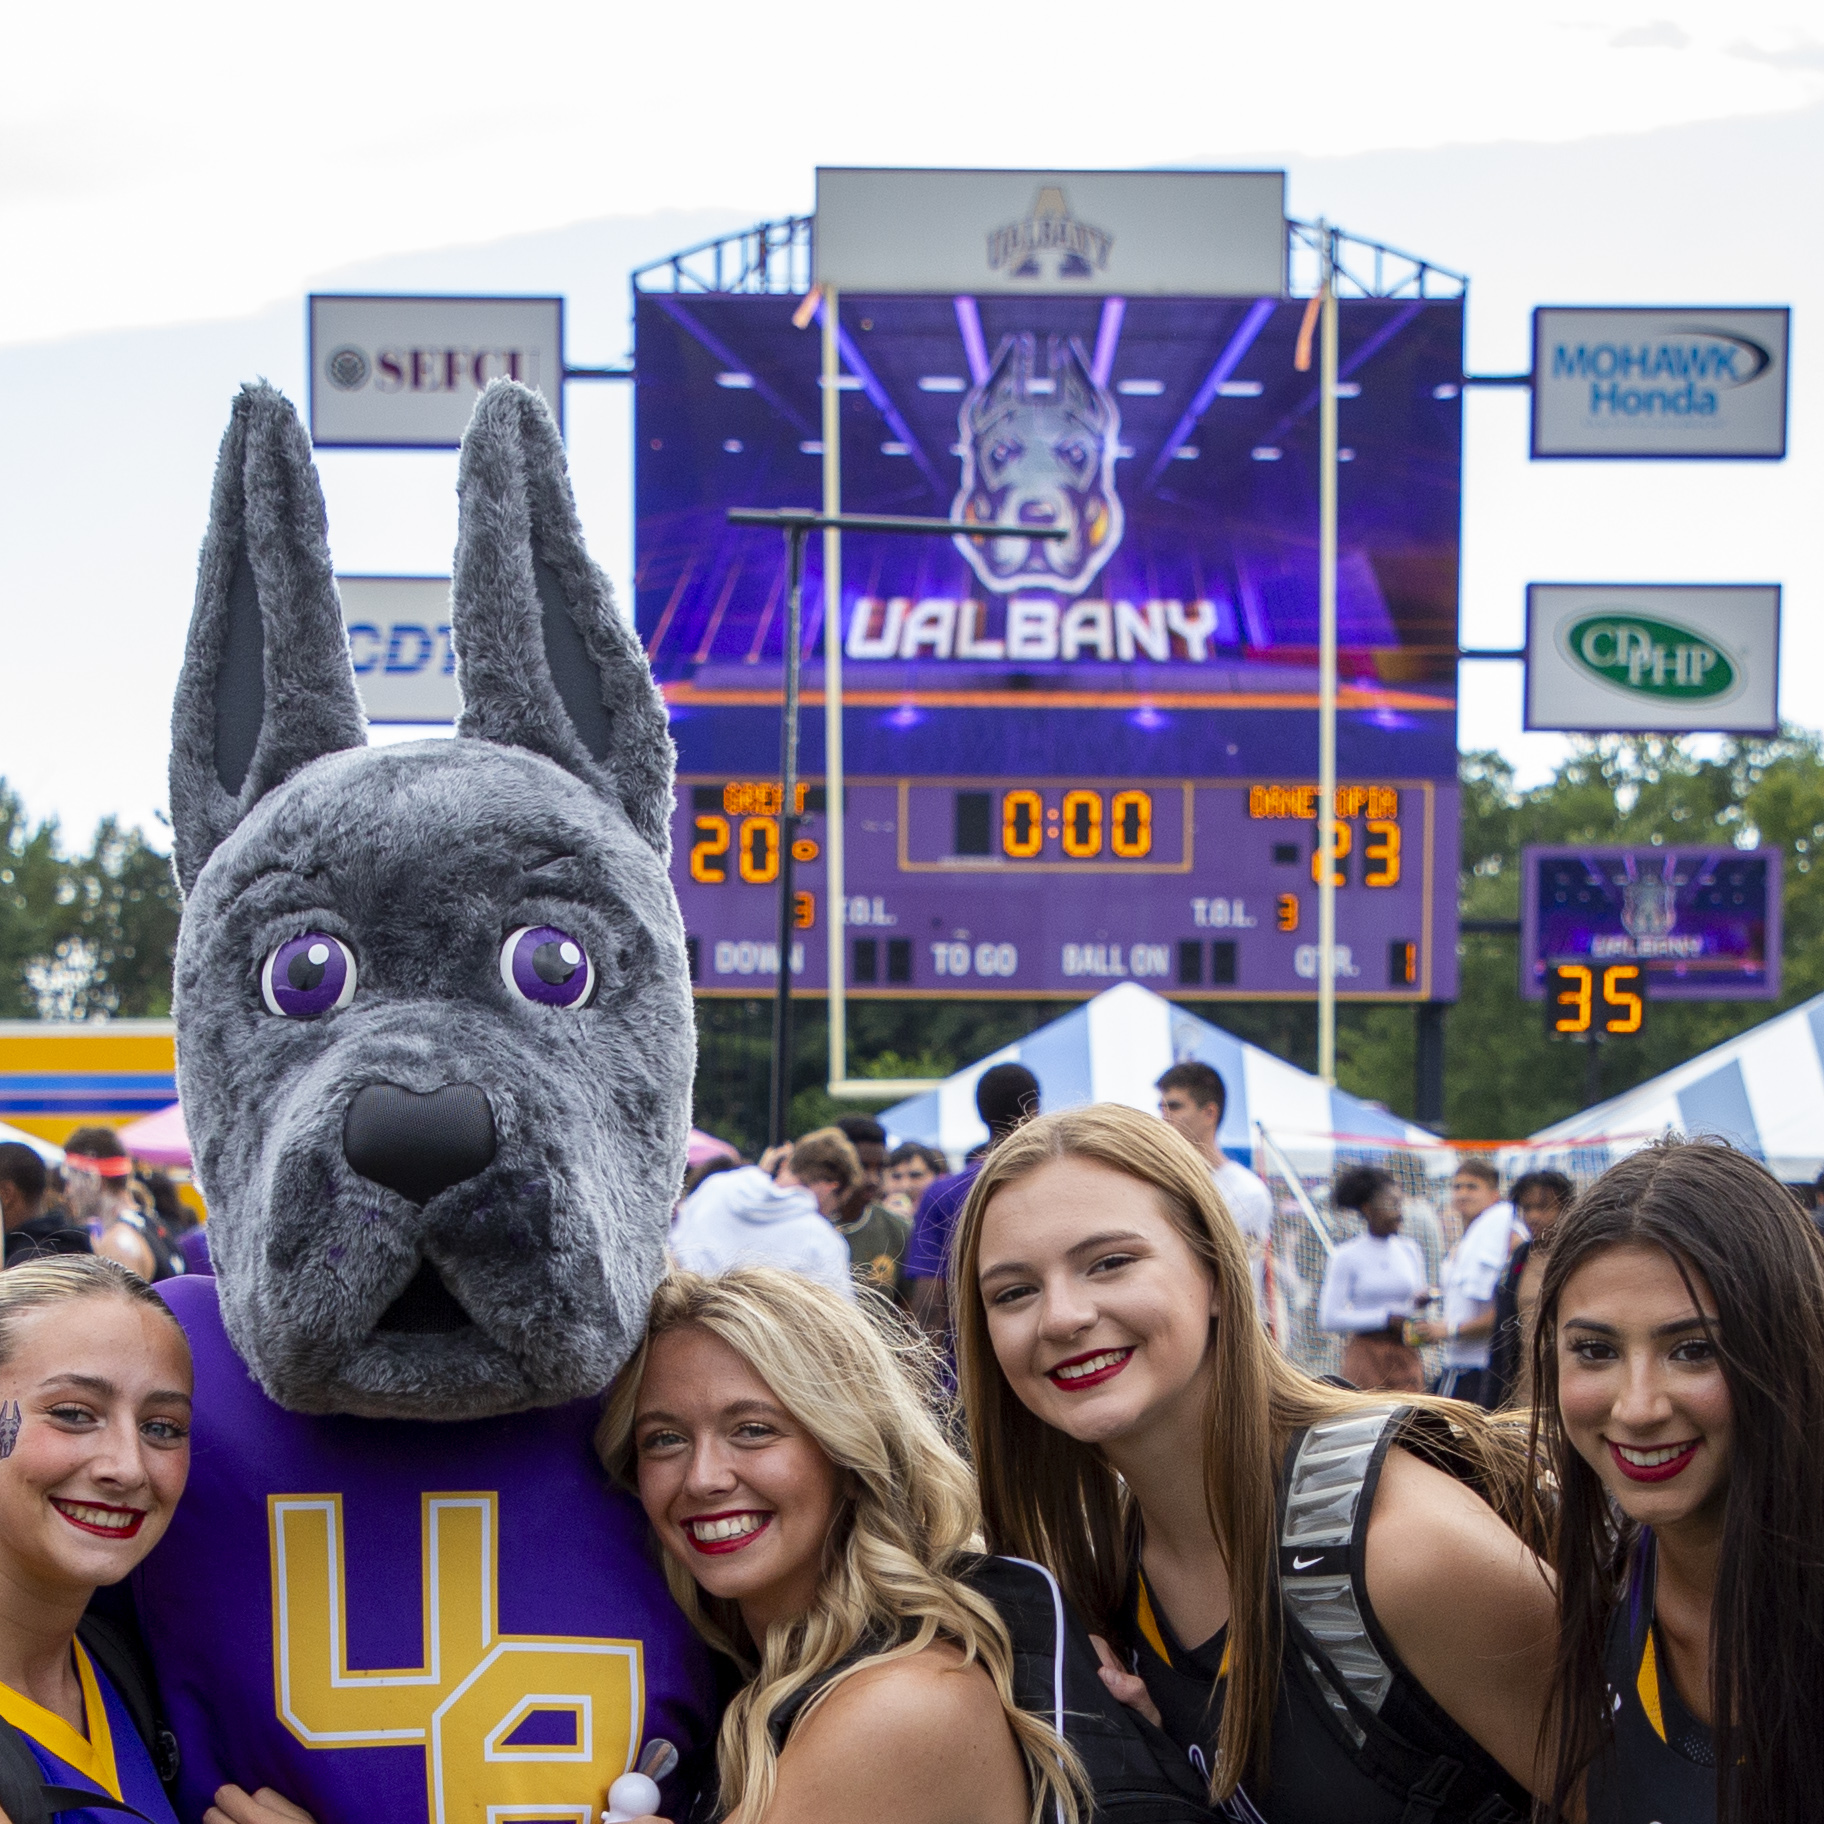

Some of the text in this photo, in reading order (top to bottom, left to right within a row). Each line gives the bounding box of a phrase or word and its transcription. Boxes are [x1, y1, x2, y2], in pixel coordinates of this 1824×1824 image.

[1552, 343, 1742, 382] MOHAWK
[1589, 380, 1718, 416] Honda
[844, 598, 1219, 663] UALBANY
[1002, 789, 1153, 858] 0:00
[690, 815, 780, 883] 20
[1311, 820, 1401, 888] 23
[1277, 892, 1299, 932] 3
[930, 941, 1019, 977] TO GO
[1061, 942, 1171, 977] BALL ON
[1294, 943, 1361, 980] QR.
[1555, 964, 1643, 1034] 35
